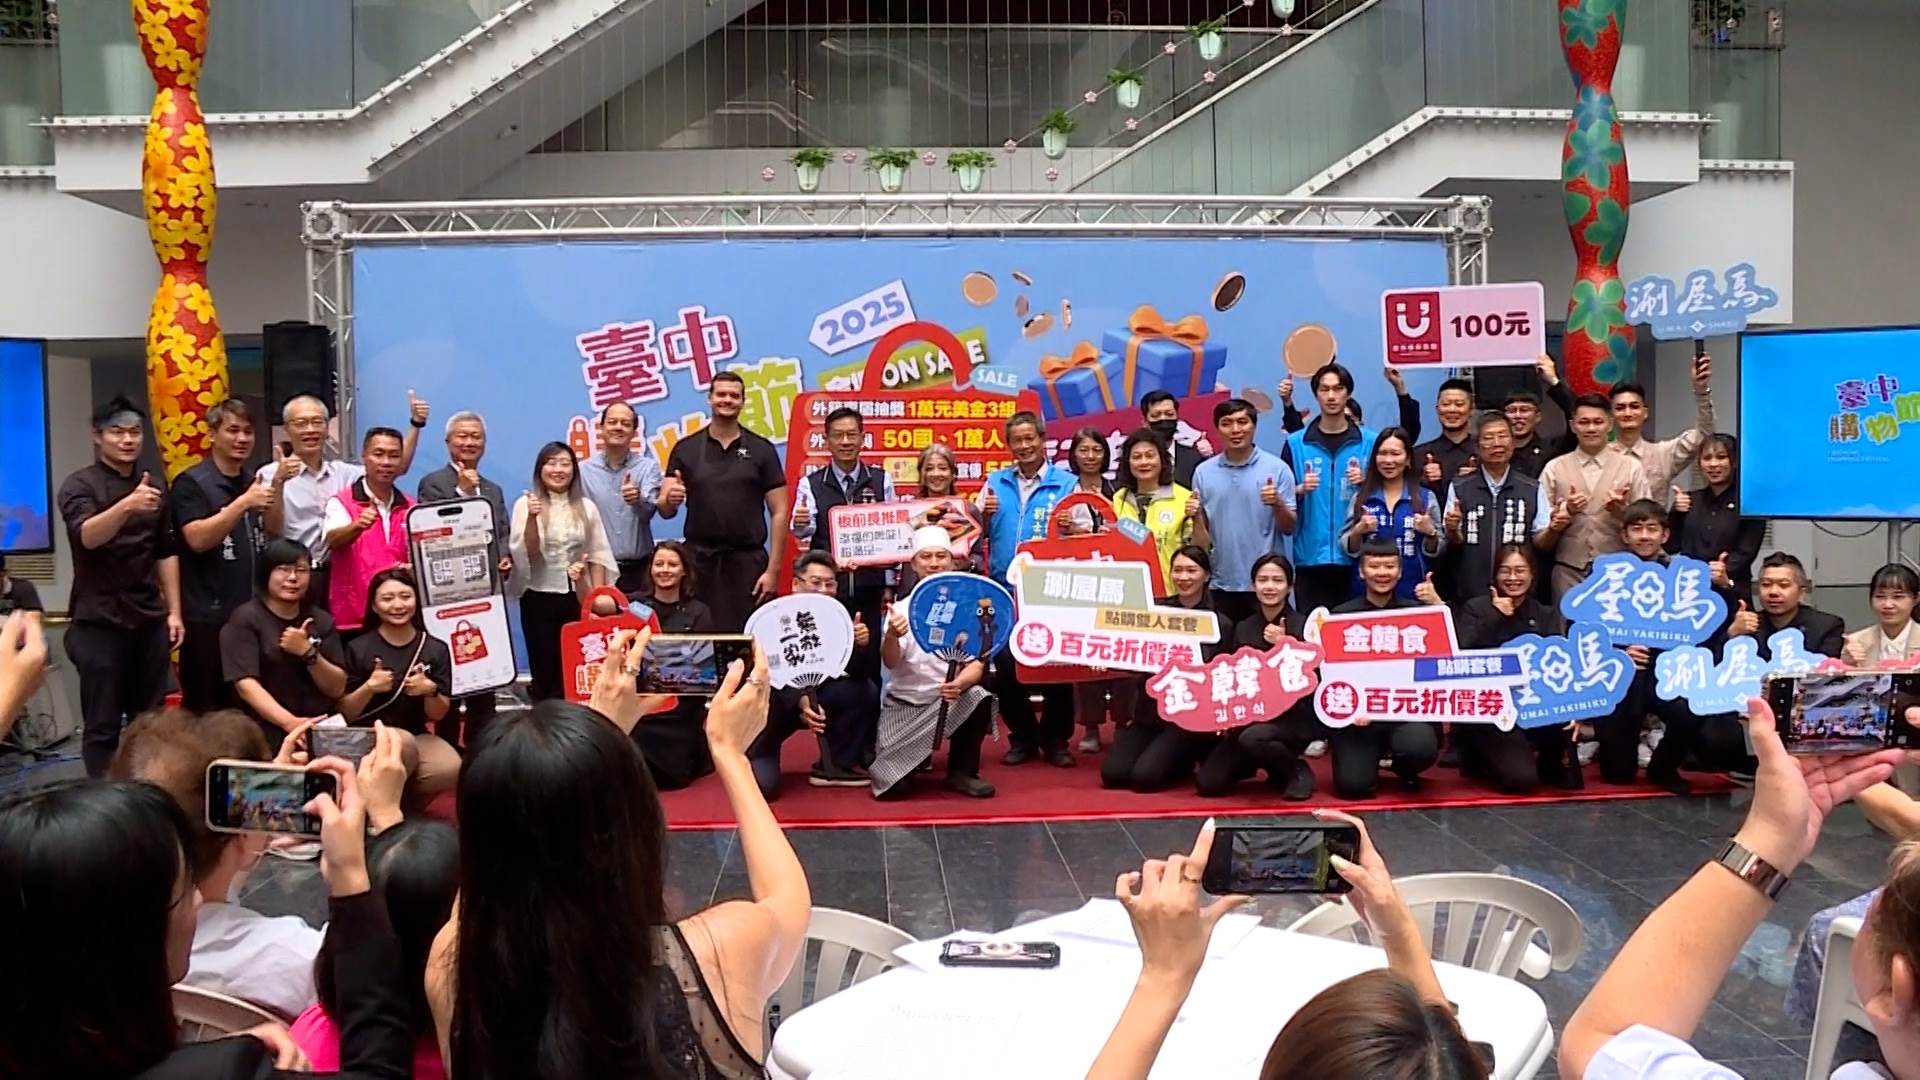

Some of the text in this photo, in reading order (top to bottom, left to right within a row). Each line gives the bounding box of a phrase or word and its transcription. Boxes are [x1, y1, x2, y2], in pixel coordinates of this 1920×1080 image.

[1630, 270, 1769, 318] 涮屋馬
[819, 292, 905, 346] 2025
[1450, 311, 1530, 338] 100元
[580, 310, 733, 407] 臺中
[882, 356, 920, 387] ON
[924, 339, 985, 376] SAE
[976, 367, 1019, 388] SALE
[1044, 571, 1125, 604] 涮屋馬
[1572, 561, 1717, 630] 屋馬
[1104, 611, 1198, 632] 點購雙人套餐
[1632, 629, 1691, 642] YAKINIKU
[1021, 625, 1050, 653] 送
[1060, 631, 1194, 667] 百元折價券
[1343, 624, 1428, 654] 金韓食
[1152, 643, 1318, 715] 金韓食
[1437, 657, 1503, 676] 點購套餐
[1326, 685, 1354, 714] 送
[1364, 687, 1504, 715] 百元折價券
[1520, 699, 1608, 721] UMAI YAKINIKU
